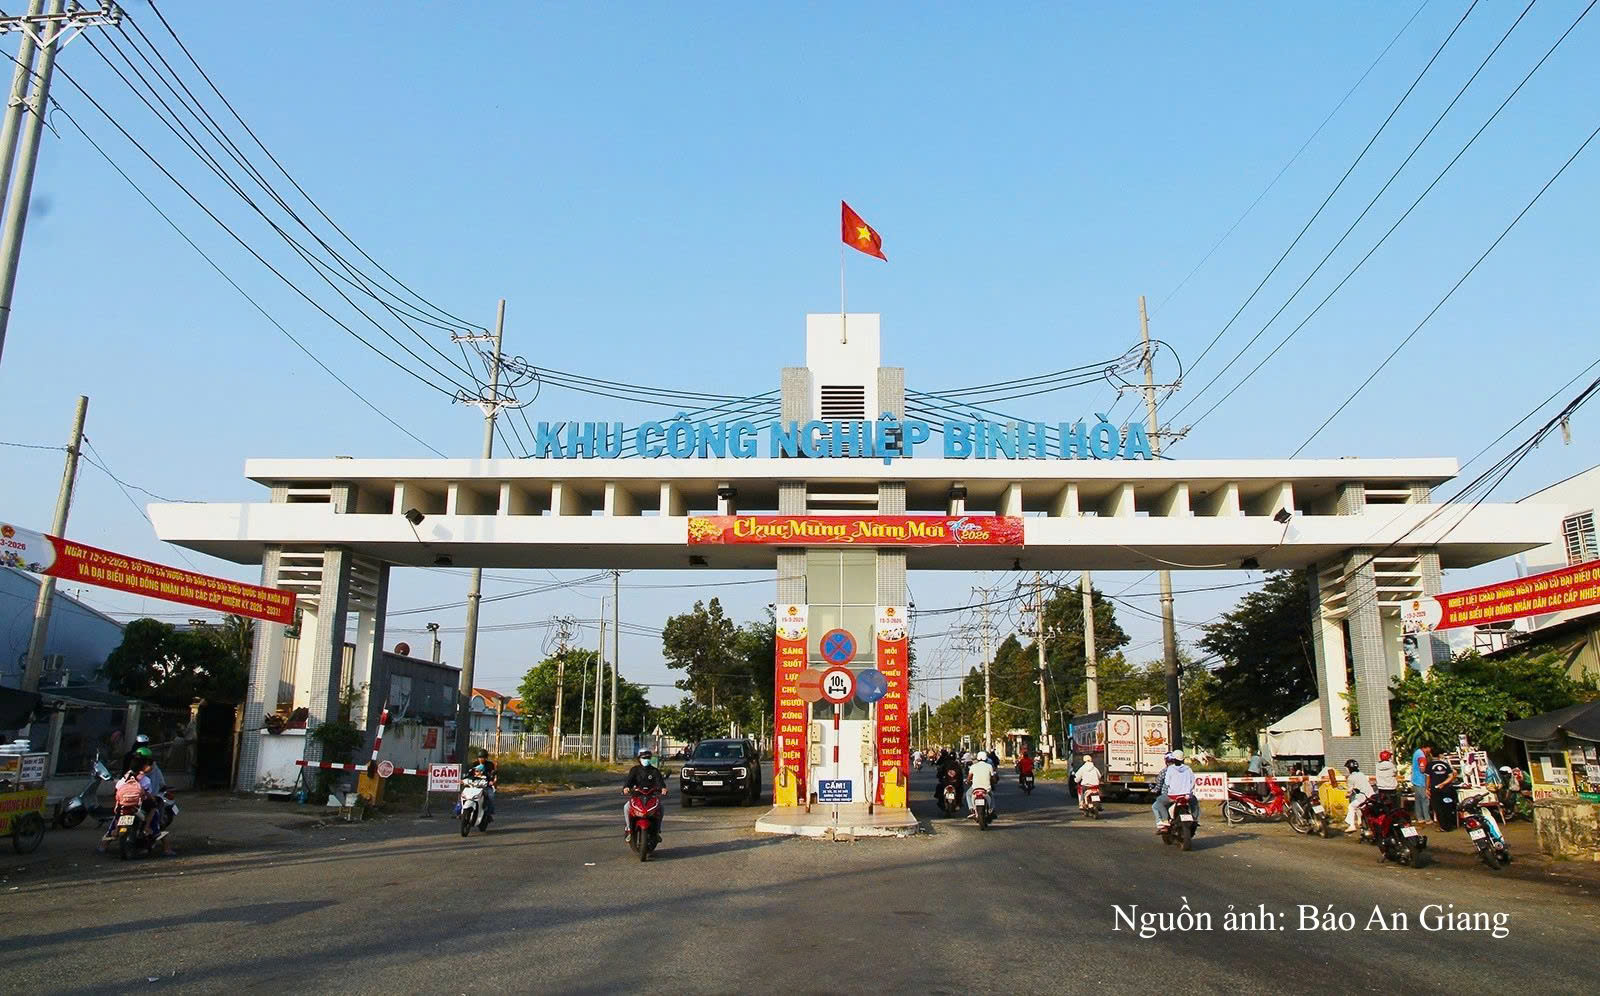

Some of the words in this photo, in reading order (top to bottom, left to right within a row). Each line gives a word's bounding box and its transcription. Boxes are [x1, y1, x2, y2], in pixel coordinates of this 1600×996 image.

[535, 421, 623, 459] KHU
[635, 411, 758, 459] CÔNG
[770, 411, 930, 465] NGHIỆP
[943, 412, 1047, 460] BÌNH
[1058, 411, 1153, 460] HÒA
[733, 517, 787, 540] Chúc
[783, 519, 854, 542] Mừng
[851, 520, 906, 539] Năm
[896, 520, 946, 540] Mới
[961, 530, 990, 540] 2026
[79, 563, 89, 575] VÀ
[91, 567, 105, 580] ĐẠI
[106, 568, 124, 583] BIỂU
[782, 647, 803, 655] SÁNG
[783, 658, 802, 668] SUỐT
[831, 676, 845, 688] 10t
[887, 680, 898, 688] ÓP
[782, 686, 797, 695] CHỌ
[887, 691, 901, 699] HẦN
[433, 766, 457, 778] CẤM
[1195, 776, 1223, 786] CẤM
